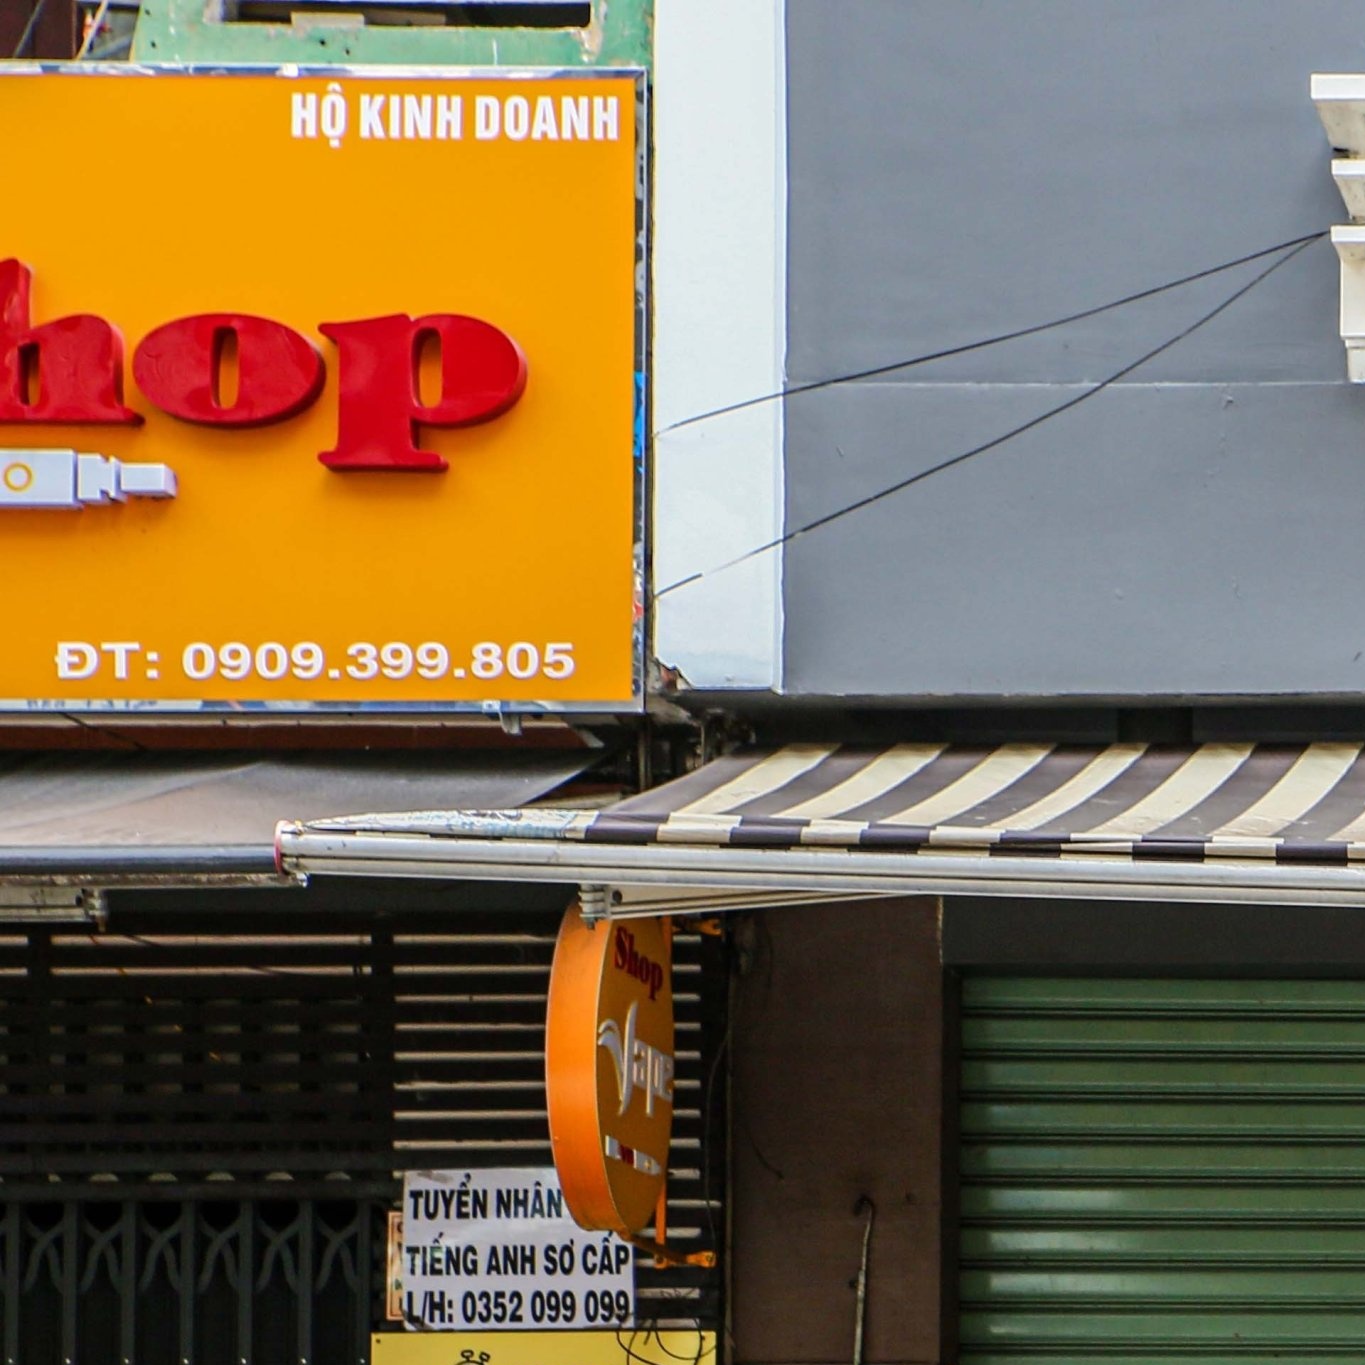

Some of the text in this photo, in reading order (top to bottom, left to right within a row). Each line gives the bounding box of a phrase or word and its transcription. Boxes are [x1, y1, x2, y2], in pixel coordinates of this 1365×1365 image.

[291, 81, 619, 149] HỘ KINH DOANH
[55, 641, 576, 680] ĐT: 0909.399.805
[615, 925, 664, 1001] Shop
[598, 1001, 675, 1118] Vape
[409, 1172, 563, 1221] TUYỂN NHÂN
[406, 1231, 479, 1276] TIẾNG
[486, 1246, 537, 1275] ANH
[543, 1238, 575, 1276] SƠ
[582, 1230, 630, 1275] CẤP
[406, 1289, 631, 1324] L/H: 0352 099 099
